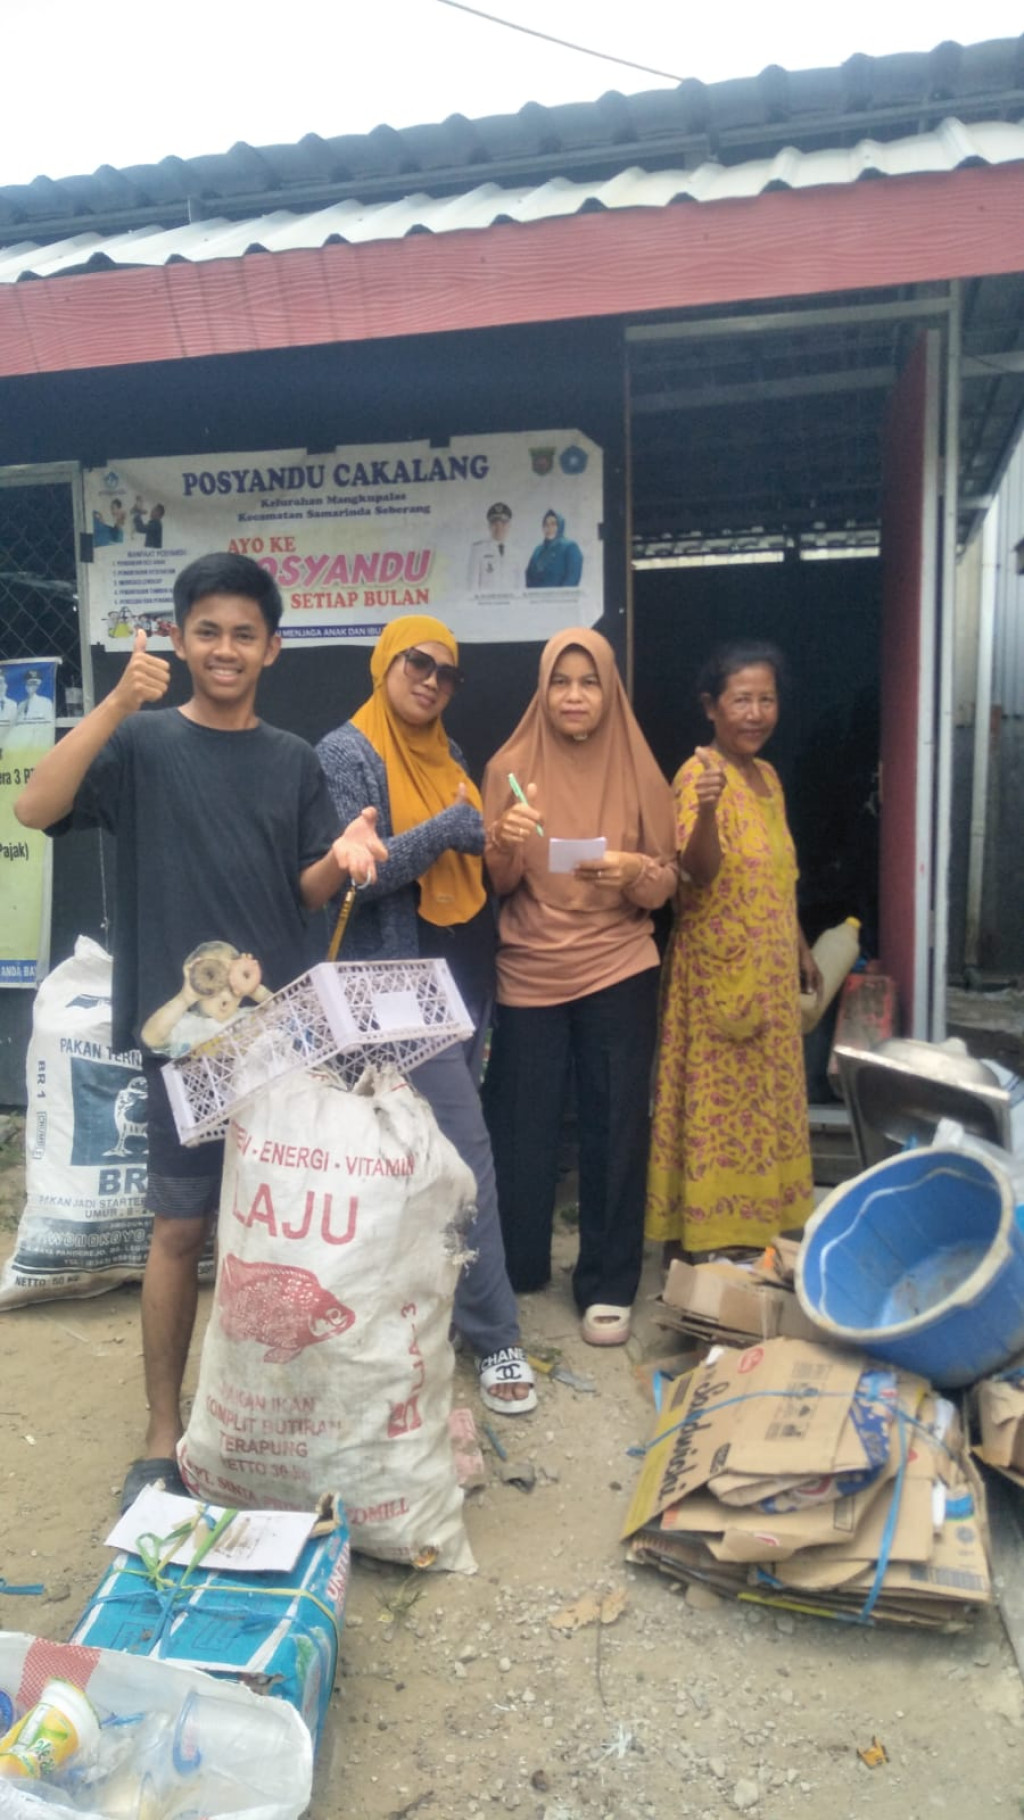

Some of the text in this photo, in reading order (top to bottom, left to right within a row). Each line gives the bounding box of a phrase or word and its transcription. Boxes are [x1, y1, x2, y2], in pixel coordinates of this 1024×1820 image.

[182, 455, 490, 496] POSYANDU CAKALANG
[237, 505, 431, 522] Kecamatan Samarinda Seberang
[228, 536, 297, 555] AYO KE
[256, 550, 432, 587] OSYANDU
[291, 588, 430, 609] SETIAP BULAN
[282, 628, 322, 638] MENJAGA
[323, 628, 347, 637] ANAK
[348, 627, 366, 636] DAN
[14, 767, 21, 785] 3
[59, 1037, 144, 1067] PAKAN TERN
[37, 1060, 47, 1099] BR 1
[259, 1140, 416, 1178] ENERGI VITAMIN
[99, 1197, 146, 1208] STARTE
[232, 1169, 359, 1246] LAJU
[85, 1208, 118, 1219] UMUR
[15, 1275, 46, 1287] NETTO
